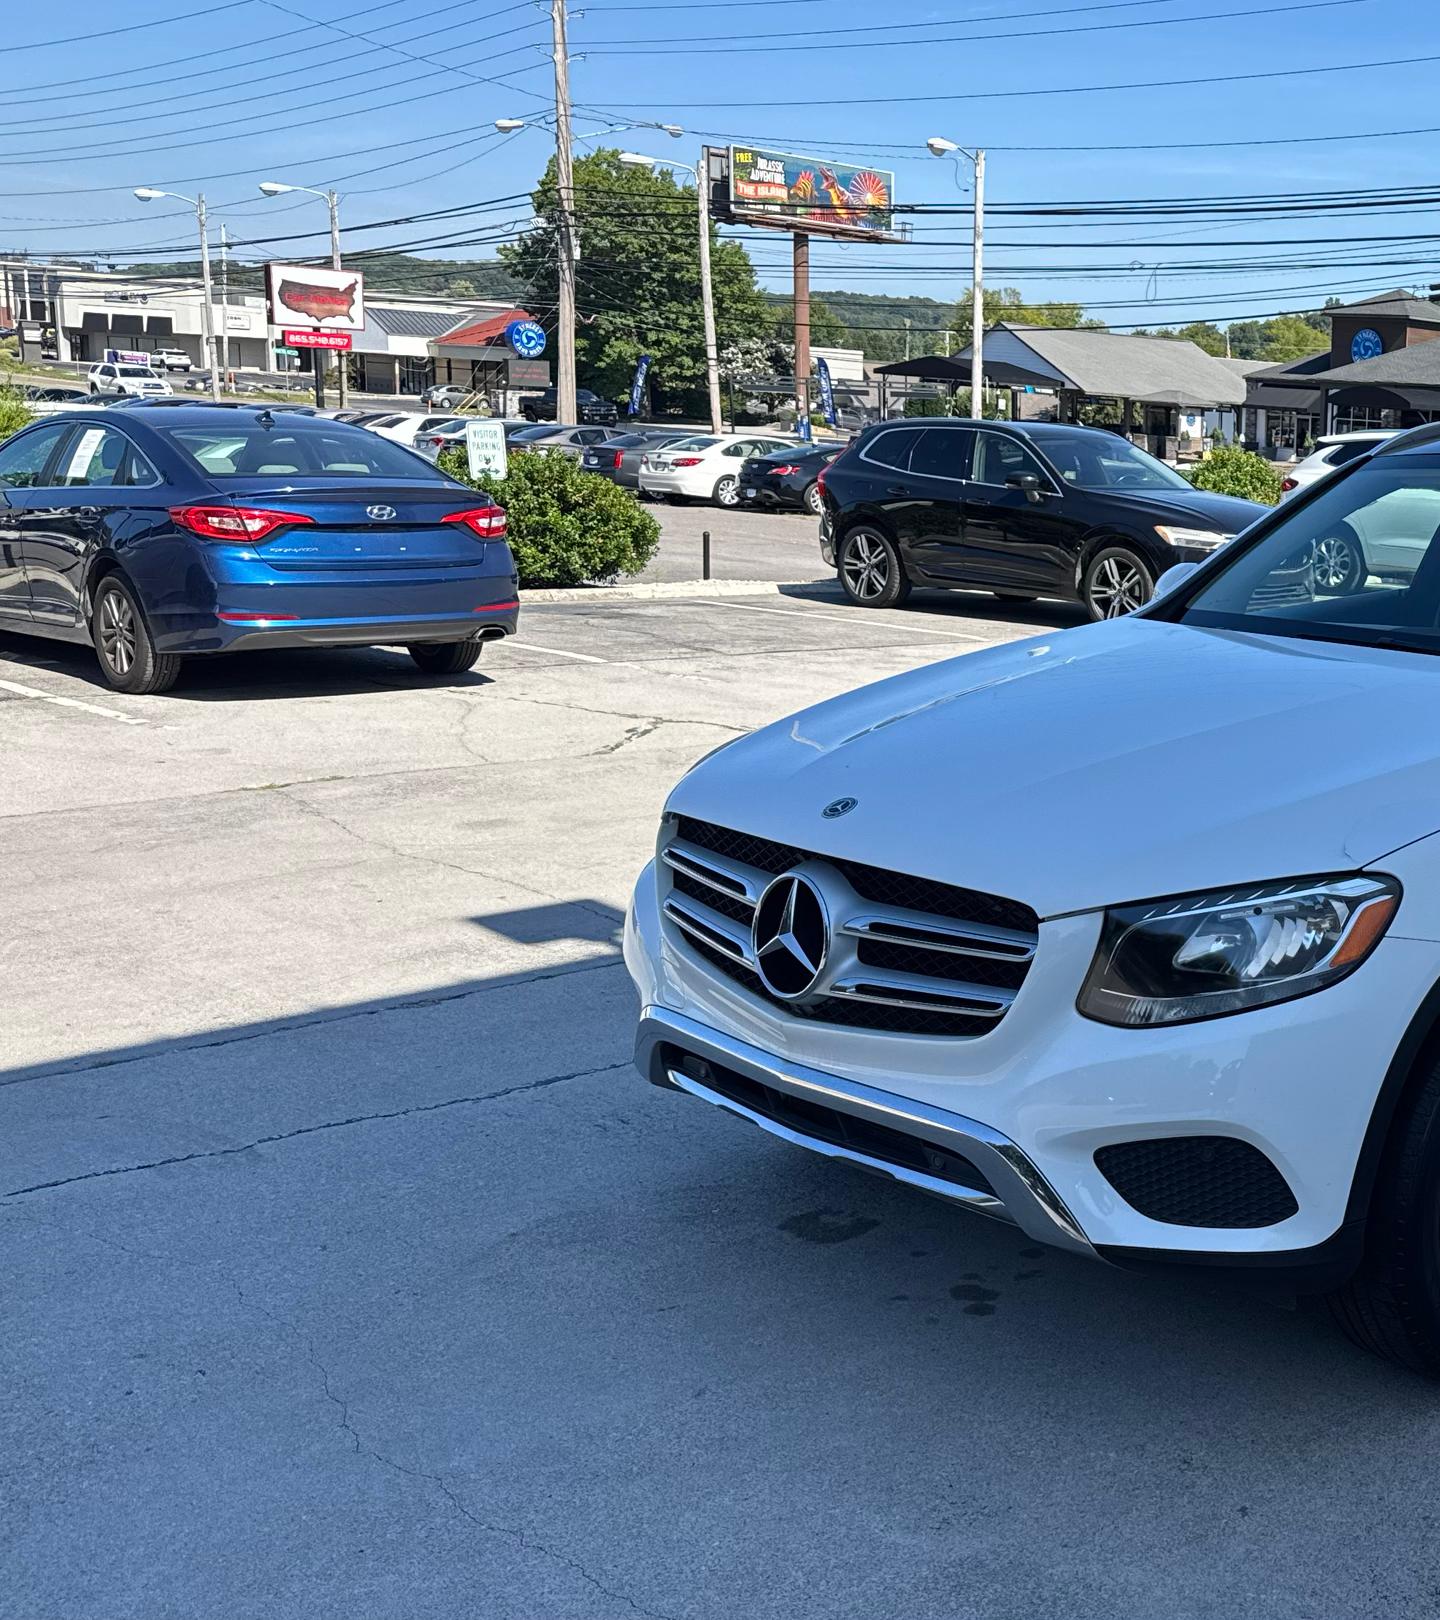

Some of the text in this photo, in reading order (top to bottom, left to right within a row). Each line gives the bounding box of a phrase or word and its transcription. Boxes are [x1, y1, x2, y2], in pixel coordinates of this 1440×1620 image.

[735, 152, 753, 163] FREE
[757, 156, 785, 173] JURASSIC
[750, 167, 786, 184] ADVENTURE
[737, 182, 788, 200] THE ISLAND
[288, 334, 349, 346] 865.540.6157
[472, 430, 498, 439] VISITOR
[471, 441, 501, 451] PARKING
